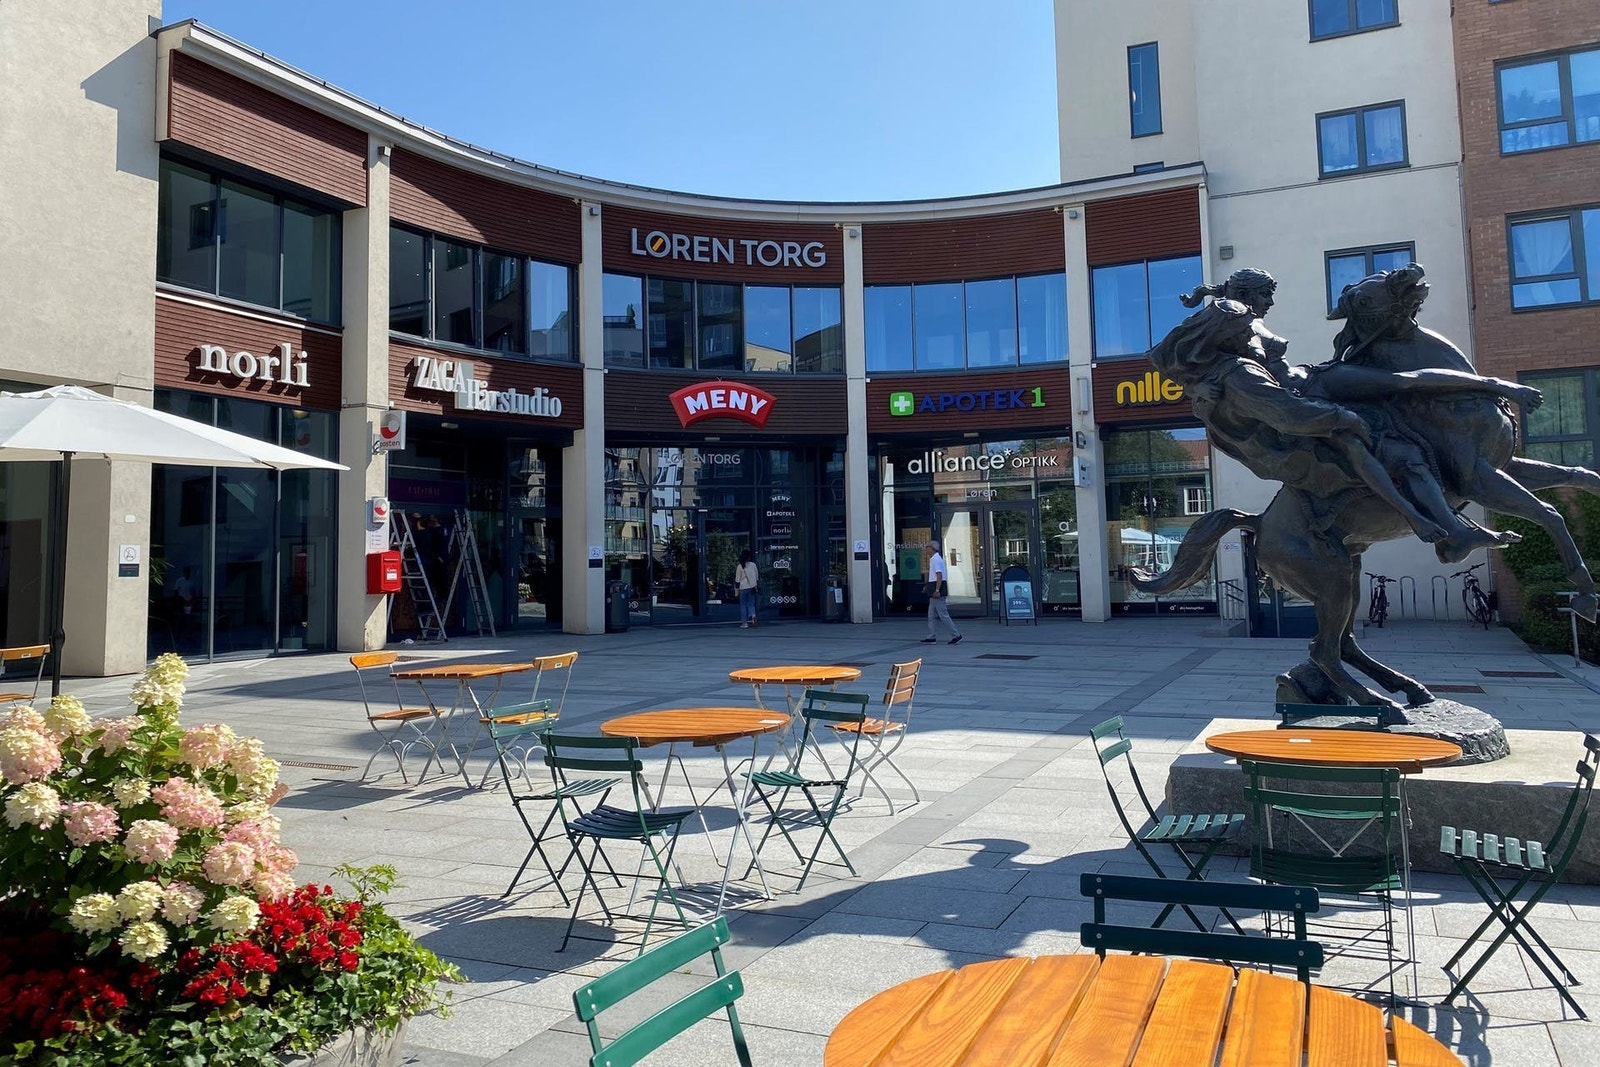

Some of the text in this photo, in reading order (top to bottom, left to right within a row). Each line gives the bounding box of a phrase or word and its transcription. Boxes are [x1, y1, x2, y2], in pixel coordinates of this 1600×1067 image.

[631, 228, 826, 268] LØREN TORG
[196, 342, 311, 388] norli
[413, 355, 468, 394] ZAGA
[466, 377, 562, 418] Hårstudio
[918, 387, 1046, 413] APOTEK 1
[1115, 372, 1184, 405] nille
[683, 389, 768, 415] MENY
[379, 439, 400, 448] posten
[708, 453, 741, 465] TORG
[1011, 455, 1058, 469] OPTIKK
[965, 488, 998, 498] Løren
